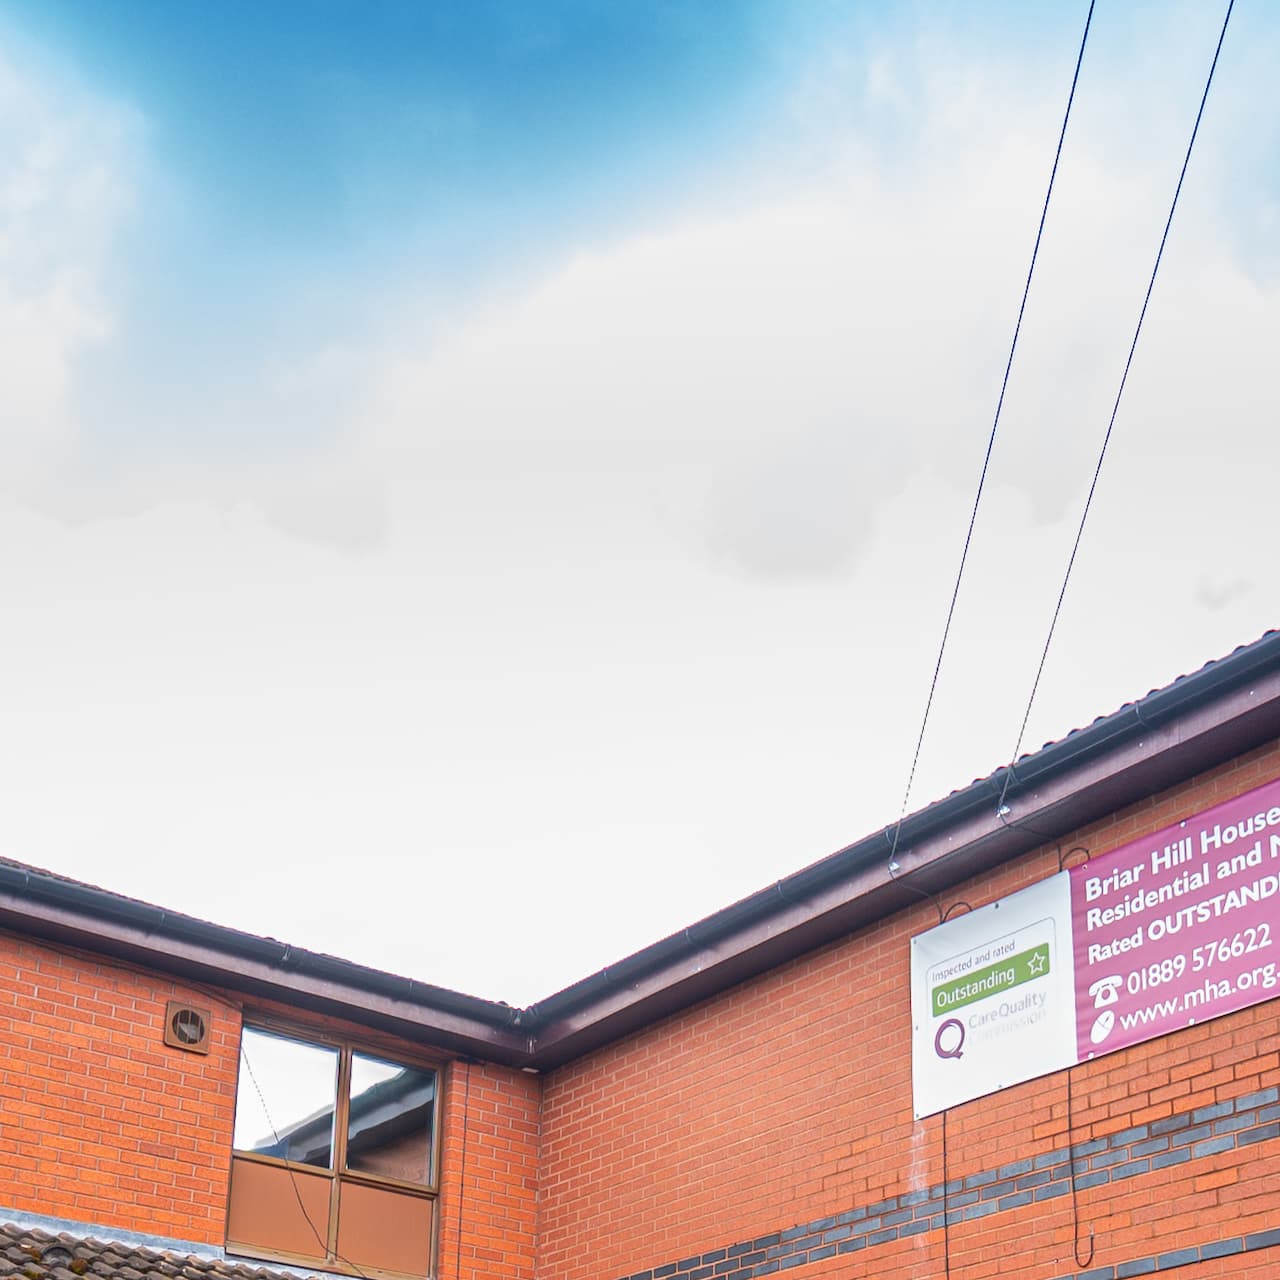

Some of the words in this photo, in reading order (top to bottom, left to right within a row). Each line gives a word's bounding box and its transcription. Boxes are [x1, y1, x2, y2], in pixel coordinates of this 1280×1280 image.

[1085, 863, 1144, 902] Briar
[1151, 837, 1192, 875] Hill
[1087, 862, 1209, 931] Residential
[1216, 841, 1262, 880] and
[932, 954, 973, 982] Inspected
[975, 948, 991, 966] and
[992, 940, 1016, 958] rated
[1087, 926, 1143, 965] Rated
[1127, 954, 1185, 995] 01889
[1191, 923, 1273, 973] 576622
[936, 966, 1015, 1007] Outstanding
